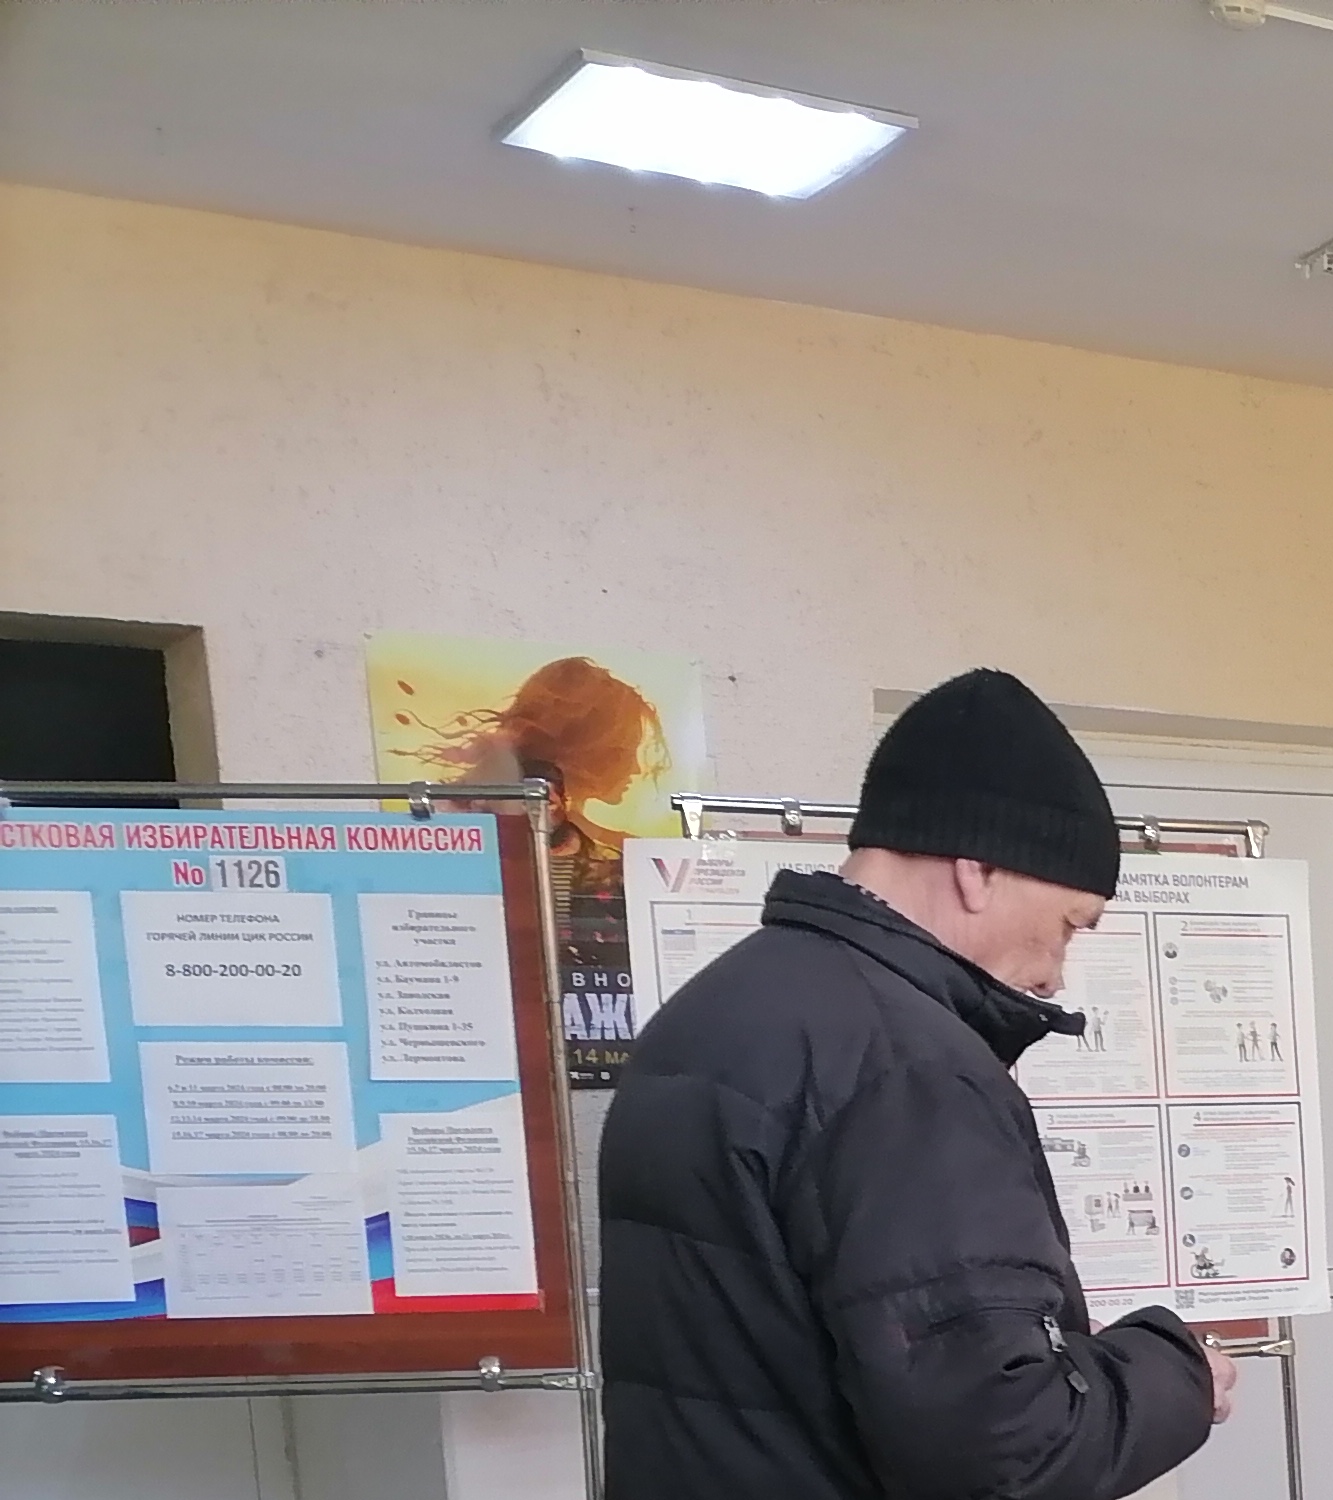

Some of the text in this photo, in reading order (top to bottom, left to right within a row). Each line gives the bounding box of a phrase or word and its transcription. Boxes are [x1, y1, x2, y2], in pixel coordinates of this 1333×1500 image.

[0, 823, 483, 852] СТКОВАЯ ИЗБИРАТЕЛЬНАЯ КОМИССИЯ
[215, 859, 281, 889] 1126
[1117, 873, 1250, 889] АМЯТКА ВОЛОНТЕРАМ
[1133, 890, 1190, 904] ВЫБОРАХ
[176, 914, 280, 923] НОМЕР ТЕЛЕФОНА
[165, 963, 302, 977] 8-800-200-00-20
[573, 1048, 599, 1065] 14
